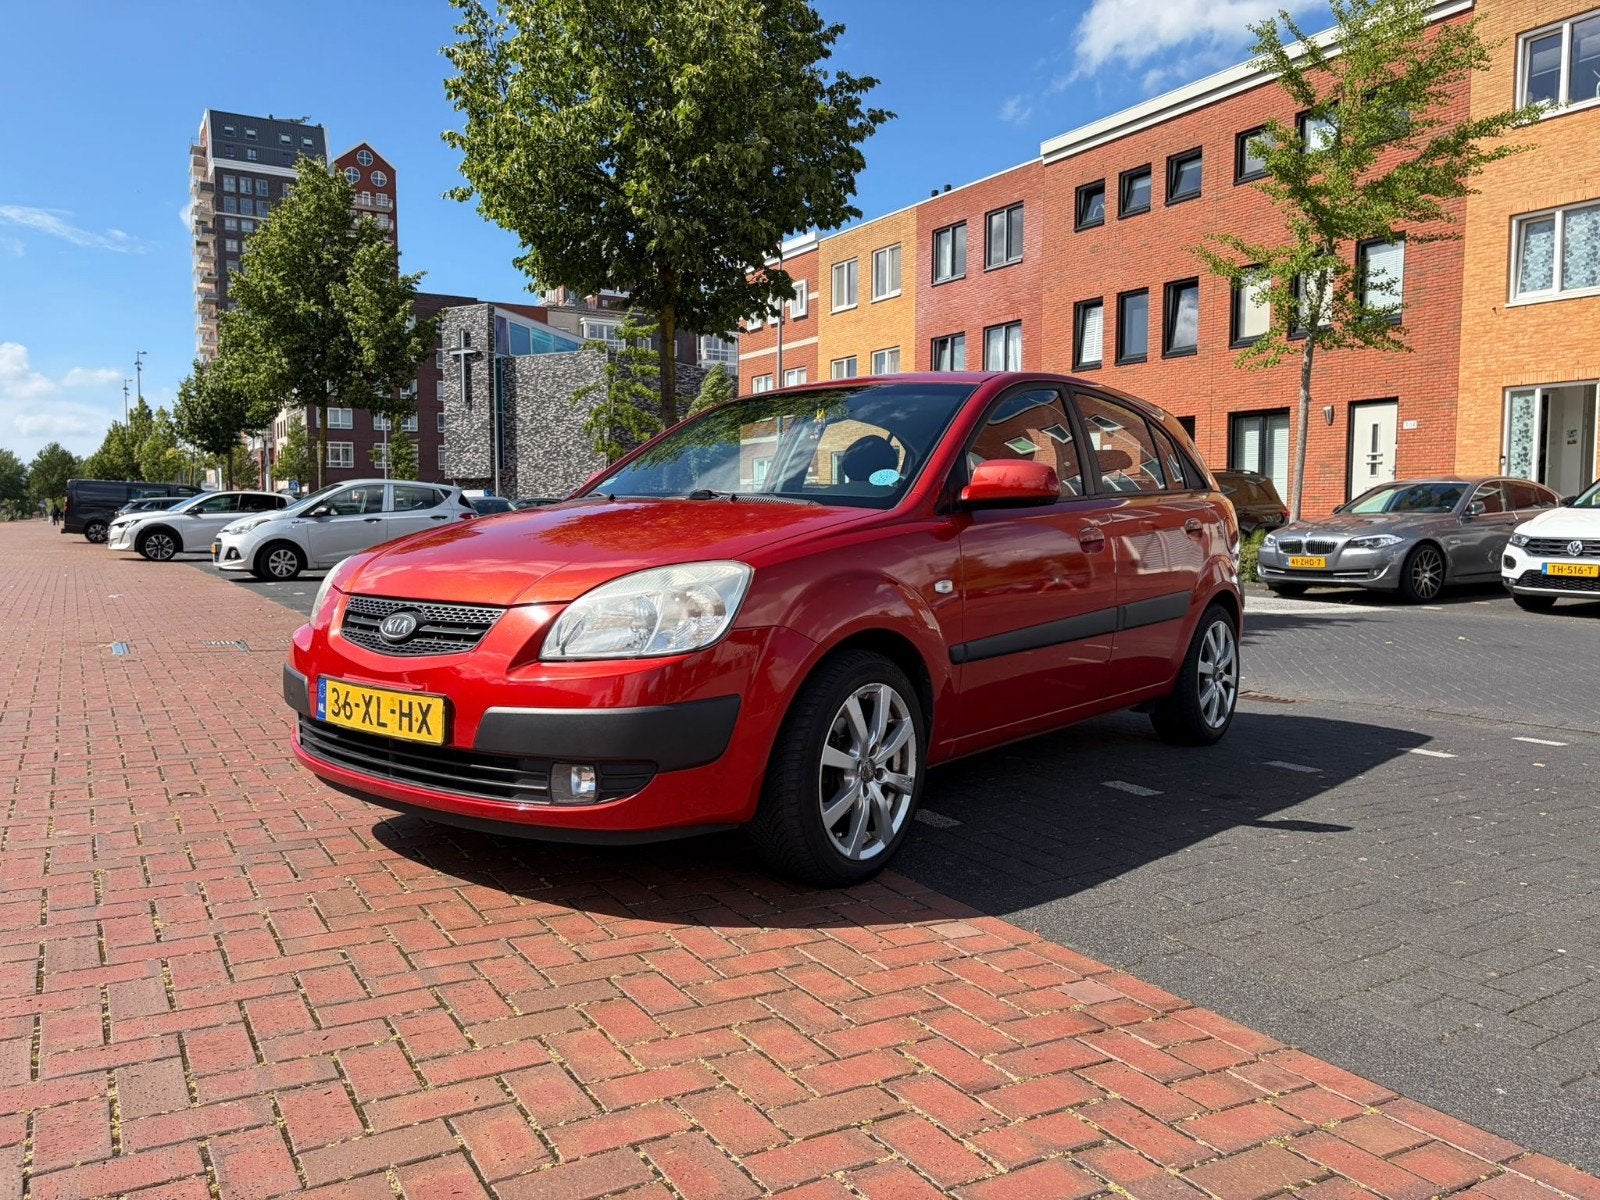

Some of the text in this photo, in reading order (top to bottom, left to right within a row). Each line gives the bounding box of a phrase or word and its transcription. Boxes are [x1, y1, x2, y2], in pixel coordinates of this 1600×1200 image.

[1552, 565, 1593, 575] TH-516-T
[385, 618, 408, 634] KIA
[331, 687, 432, 735] 36-XL-HX
